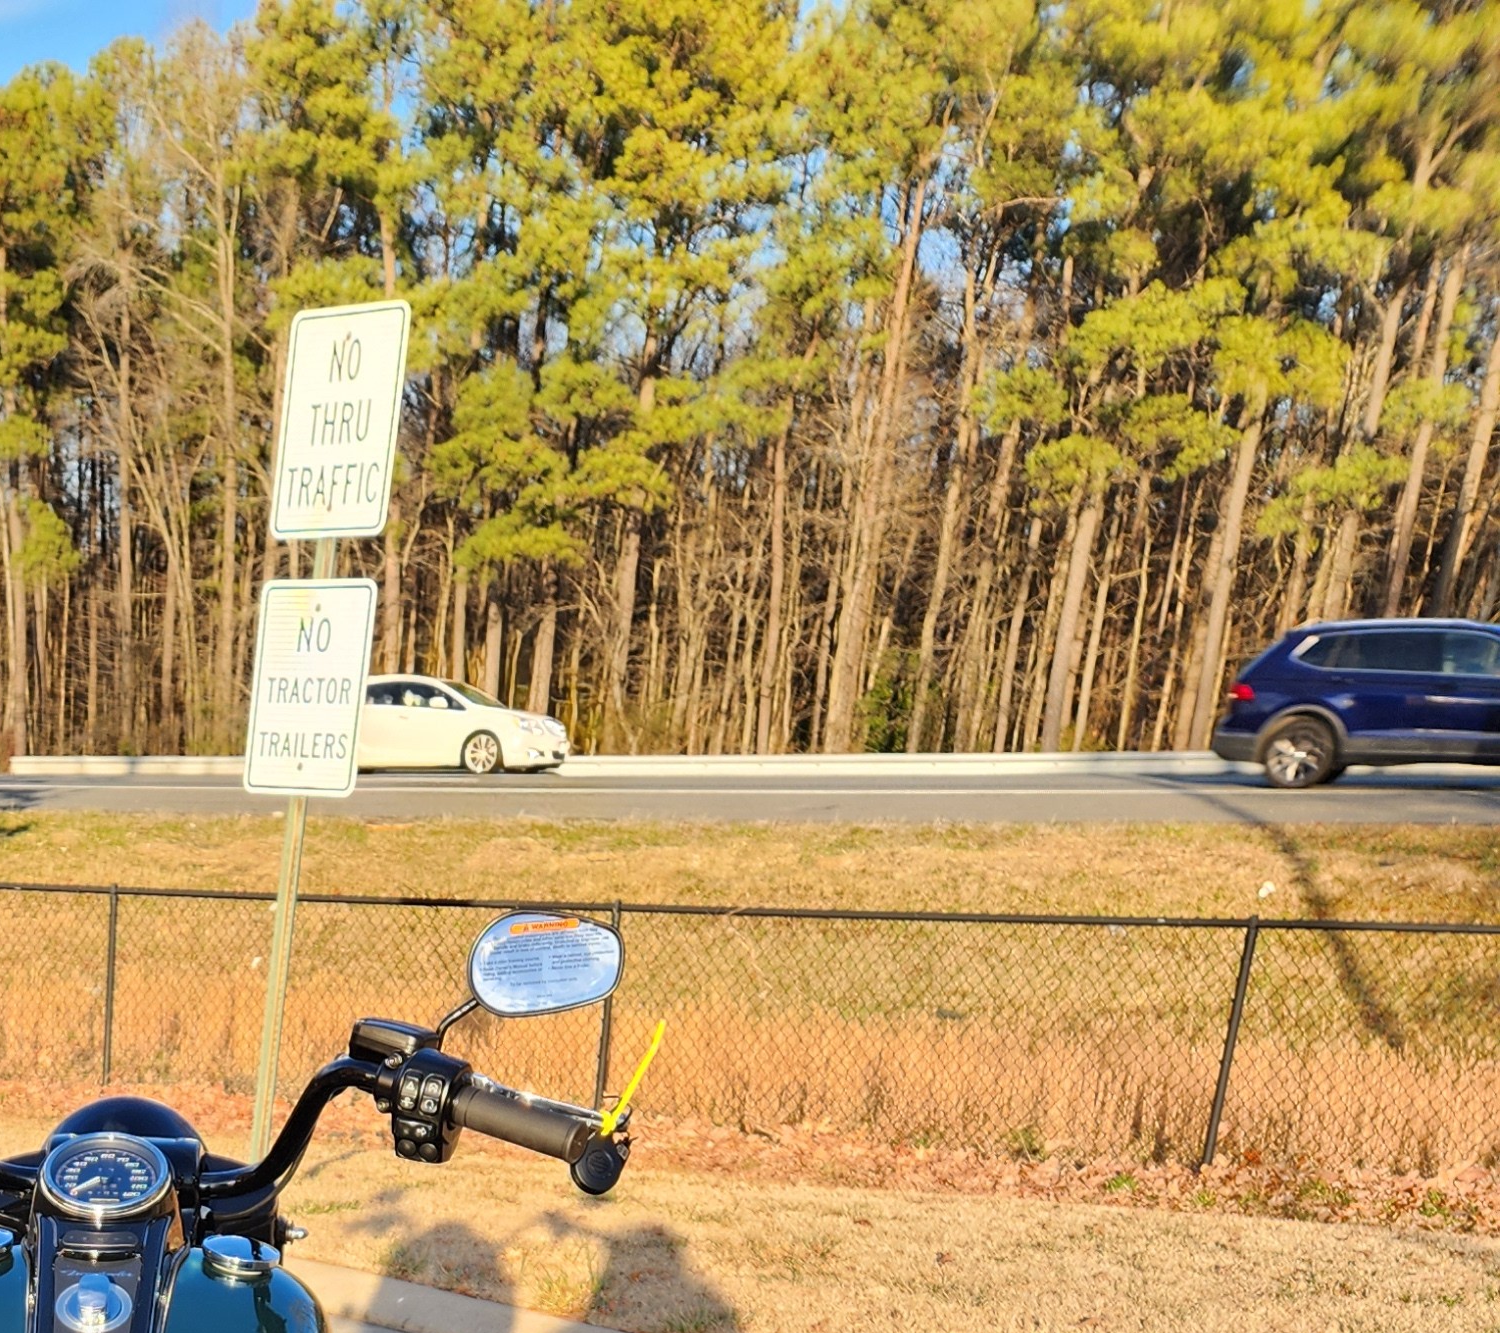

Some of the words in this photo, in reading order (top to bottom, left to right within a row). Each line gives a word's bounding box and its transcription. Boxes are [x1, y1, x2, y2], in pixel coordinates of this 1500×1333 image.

[328, 338, 362, 383] NO
[310, 398, 372, 447] THRU
[287, 461, 380, 509] TRAFFIC
[296, 617, 332, 654] NO
[267, 676, 352, 706] TRACTOR
[258, 731, 348, 761] TRAILERS
